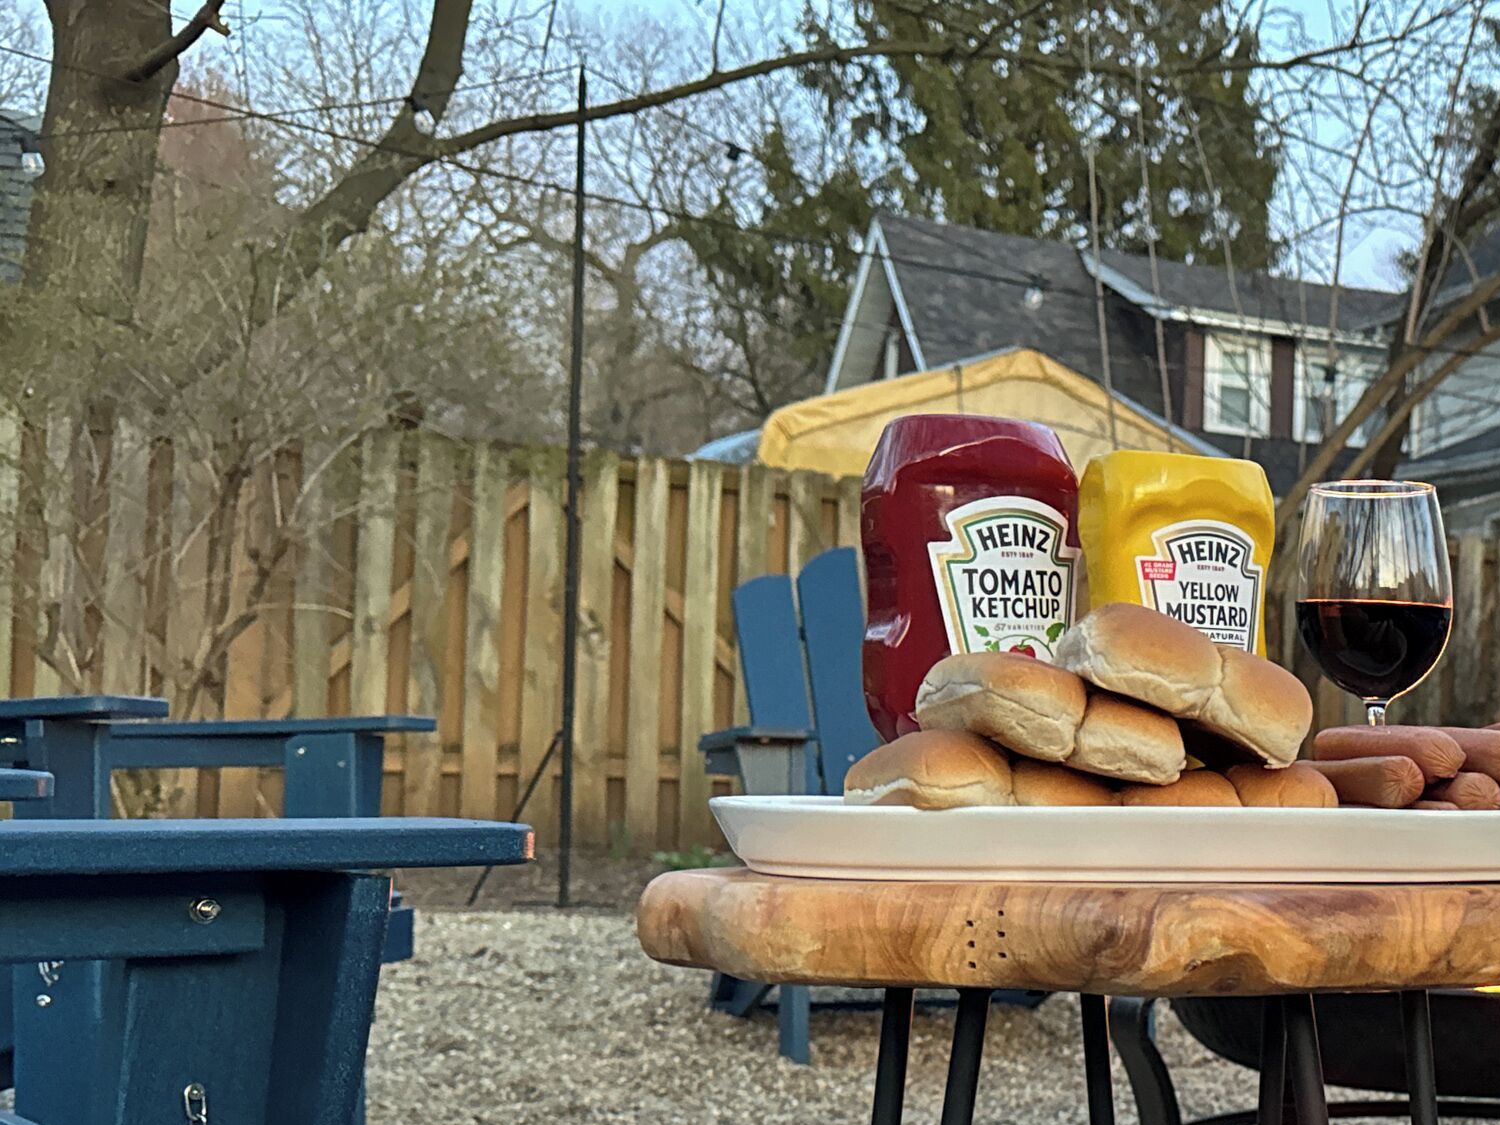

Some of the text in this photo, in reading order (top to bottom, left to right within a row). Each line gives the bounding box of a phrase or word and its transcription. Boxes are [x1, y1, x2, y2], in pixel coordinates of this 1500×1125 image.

[976, 523, 1051, 554] HEINZ
[1177, 540, 1241, 568] HEINZ
[962, 568, 1061, 597] TOMATO
[1179, 581, 1239, 603] YELLOW
[971, 597, 1060, 619] KETCHUP
[1166, 602, 1247, 628] MUSTARD
[994, 623, 1006, 631] 57
